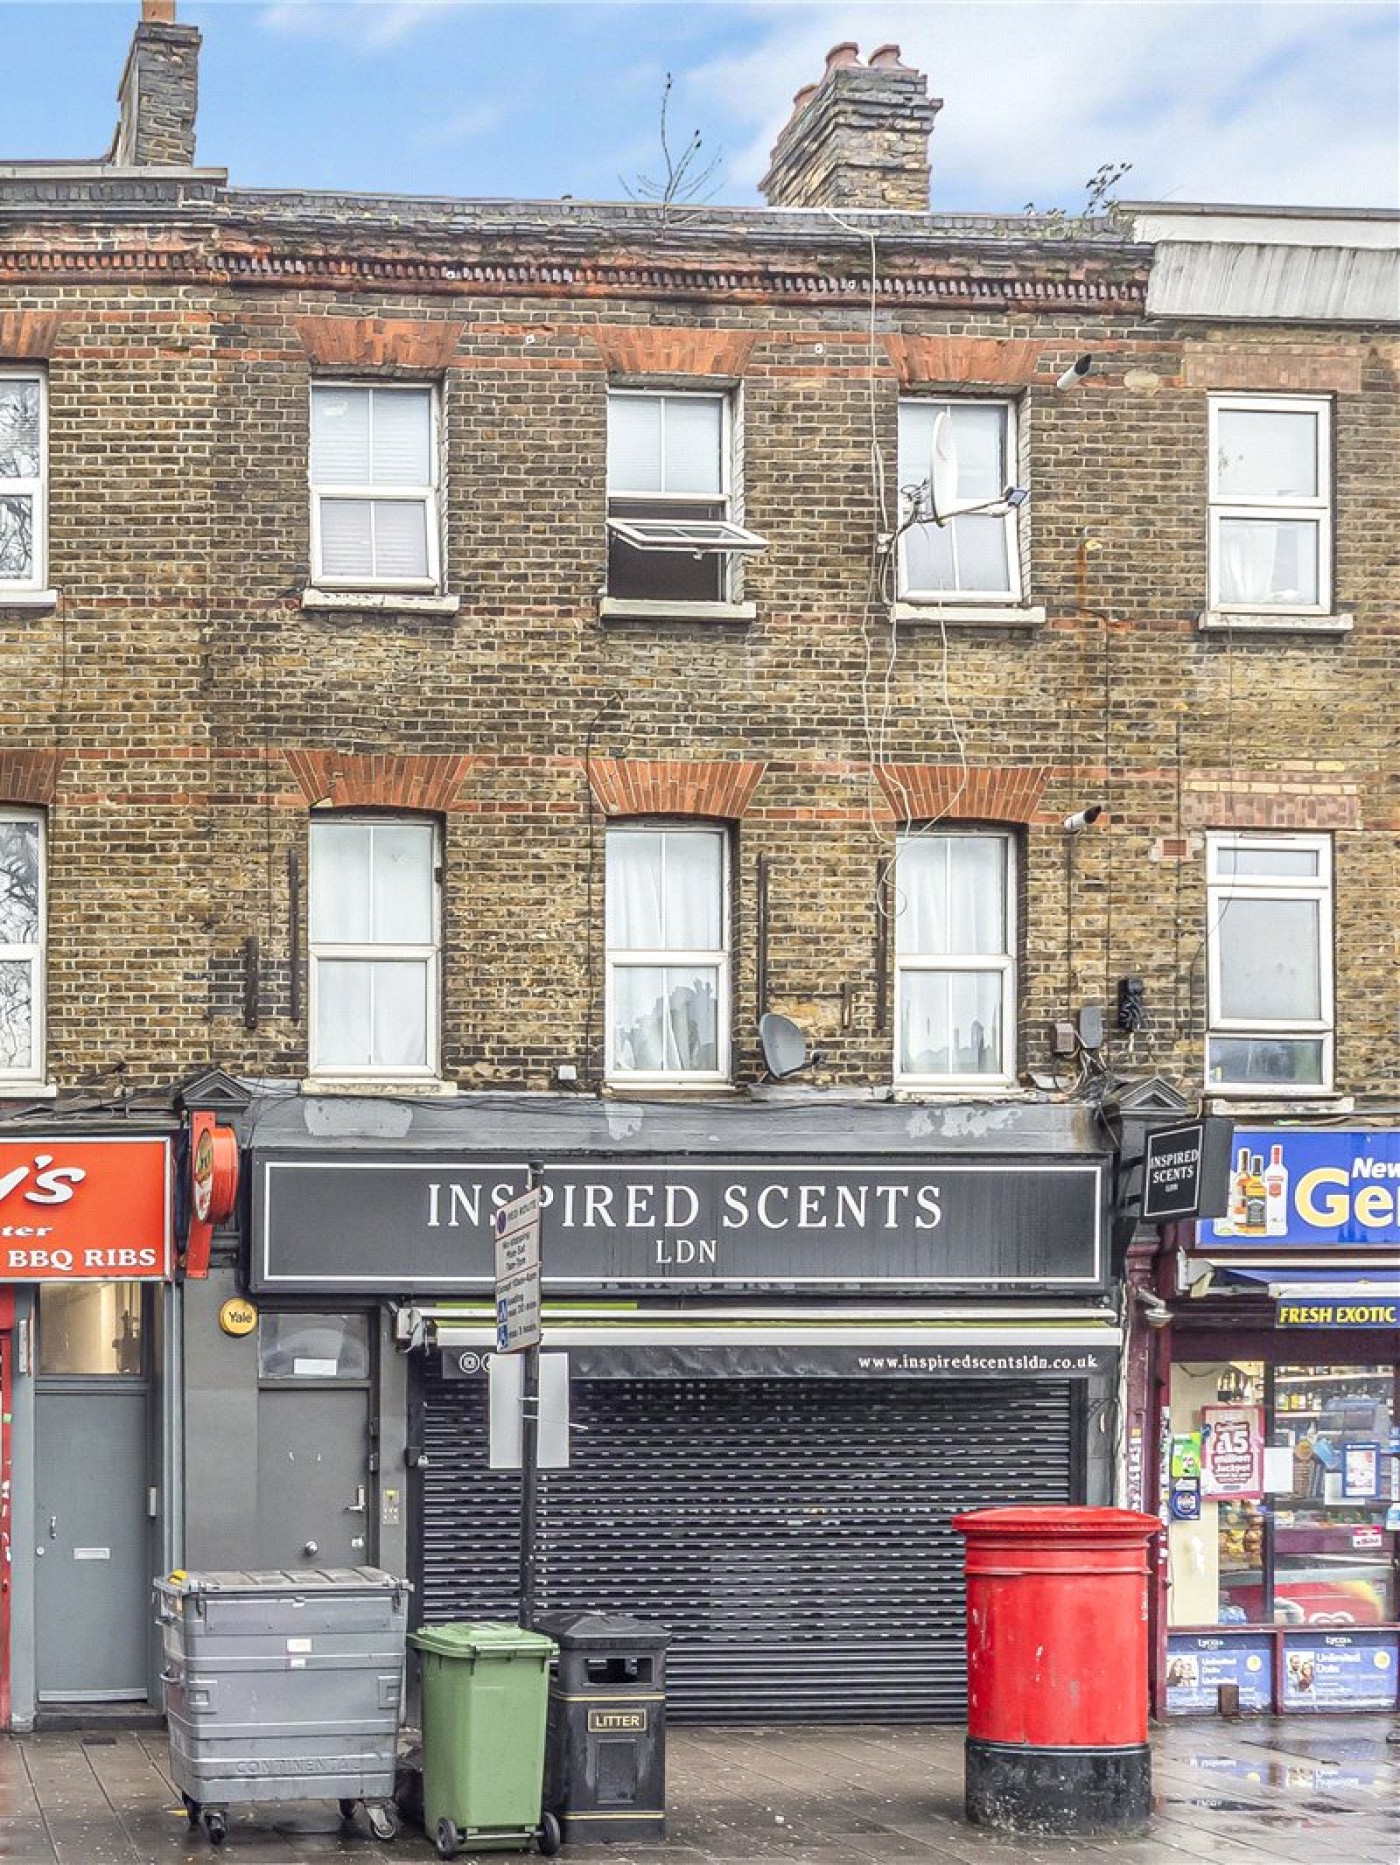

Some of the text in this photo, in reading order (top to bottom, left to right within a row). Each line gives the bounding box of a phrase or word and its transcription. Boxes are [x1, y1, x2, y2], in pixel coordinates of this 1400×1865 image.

[1150, 1149, 1199, 1169] INSPIRED
[1152, 1165, 1194, 1184] SCENTS
[722, 1184, 943, 1229] SCENTS
[1294, 1166, 1400, 1229] Ge
[8, 1249, 73, 1270] BBQ
[84, 1248, 156, 1267] RIBS
[656, 1239, 717, 1263] LDN
[228, 1311, 252, 1323] Yale
[1279, 1306, 1396, 1323] FRESH EXOTIC
[858, 1354, 1098, 1371] www.inspiredscentsldn.co.uk
[596, 1714, 640, 1727] LITTER
